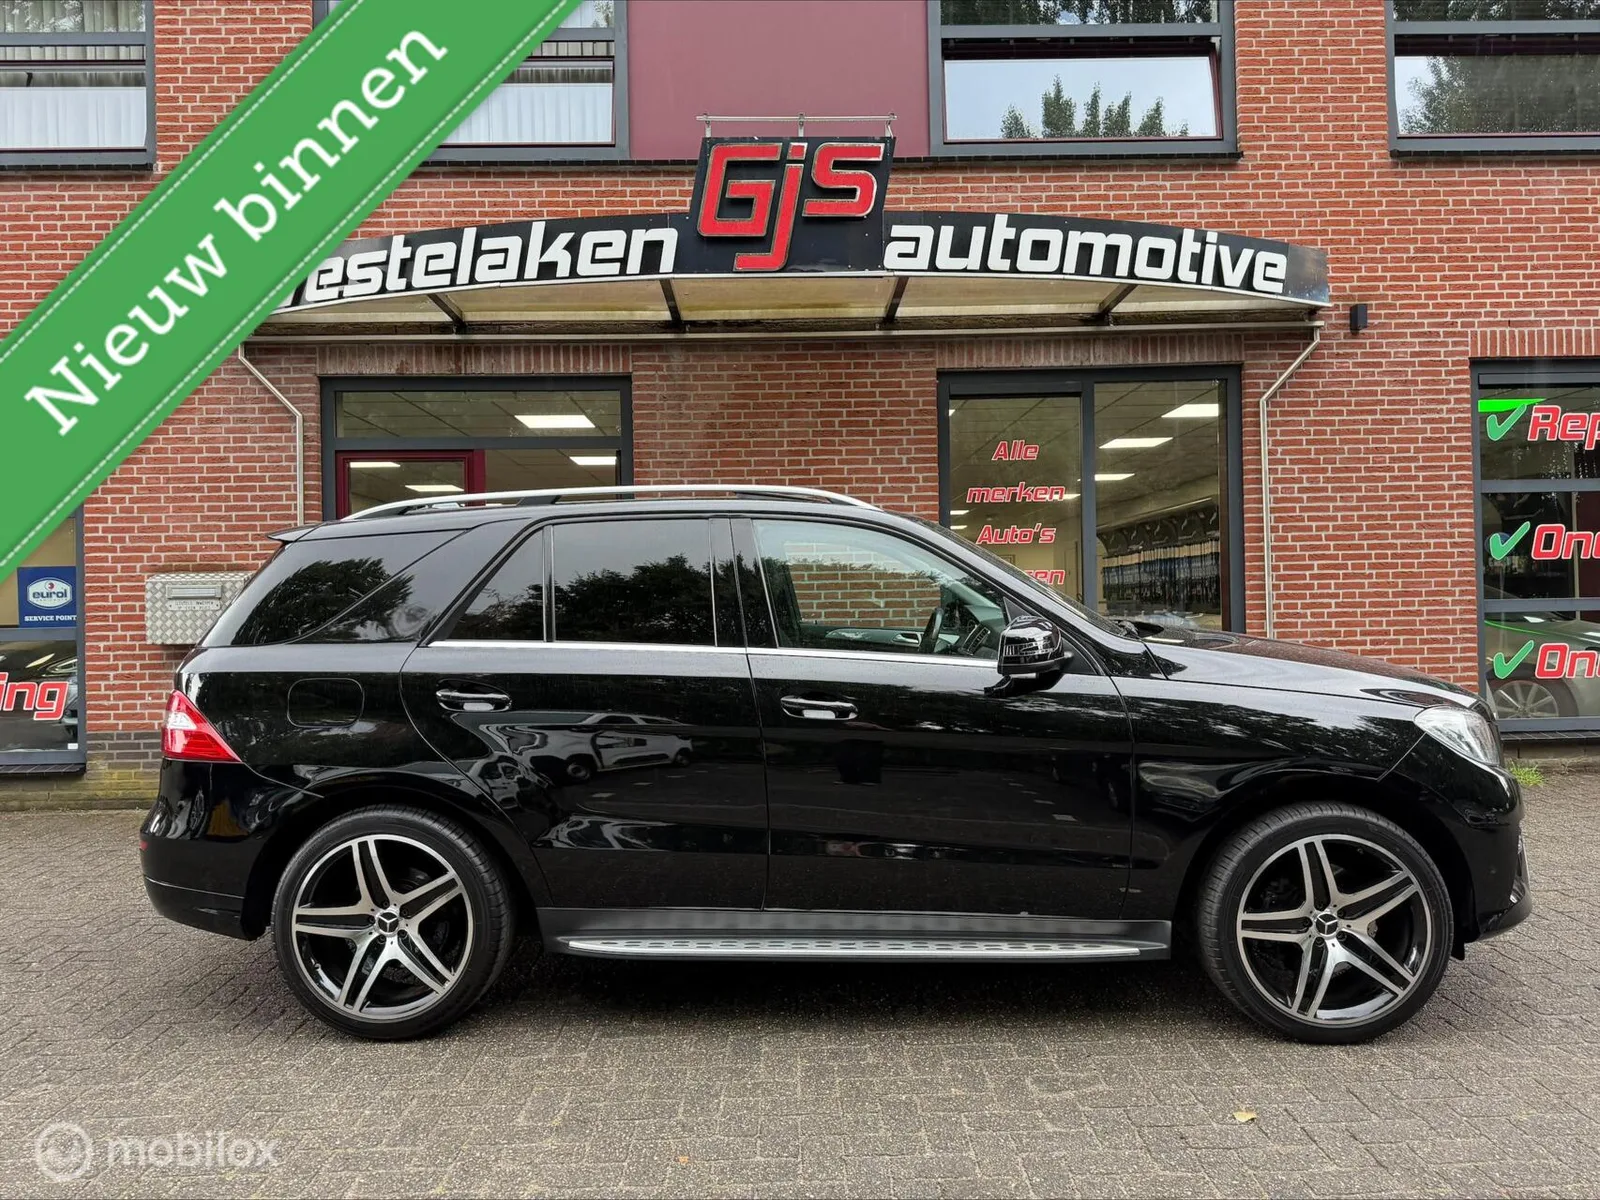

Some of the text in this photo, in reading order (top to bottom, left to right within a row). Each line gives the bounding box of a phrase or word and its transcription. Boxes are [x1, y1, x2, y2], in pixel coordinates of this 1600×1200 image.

[278, 213, 1288, 308] estelaken automotive
[991, 440, 1039, 461] Alle
[966, 481, 1066, 503] merken
[975, 522, 1057, 545] Auto's
[1530, 523, 1600, 560] On
[32, 588, 68, 599] eurol
[1534, 642, 1600, 680] On
